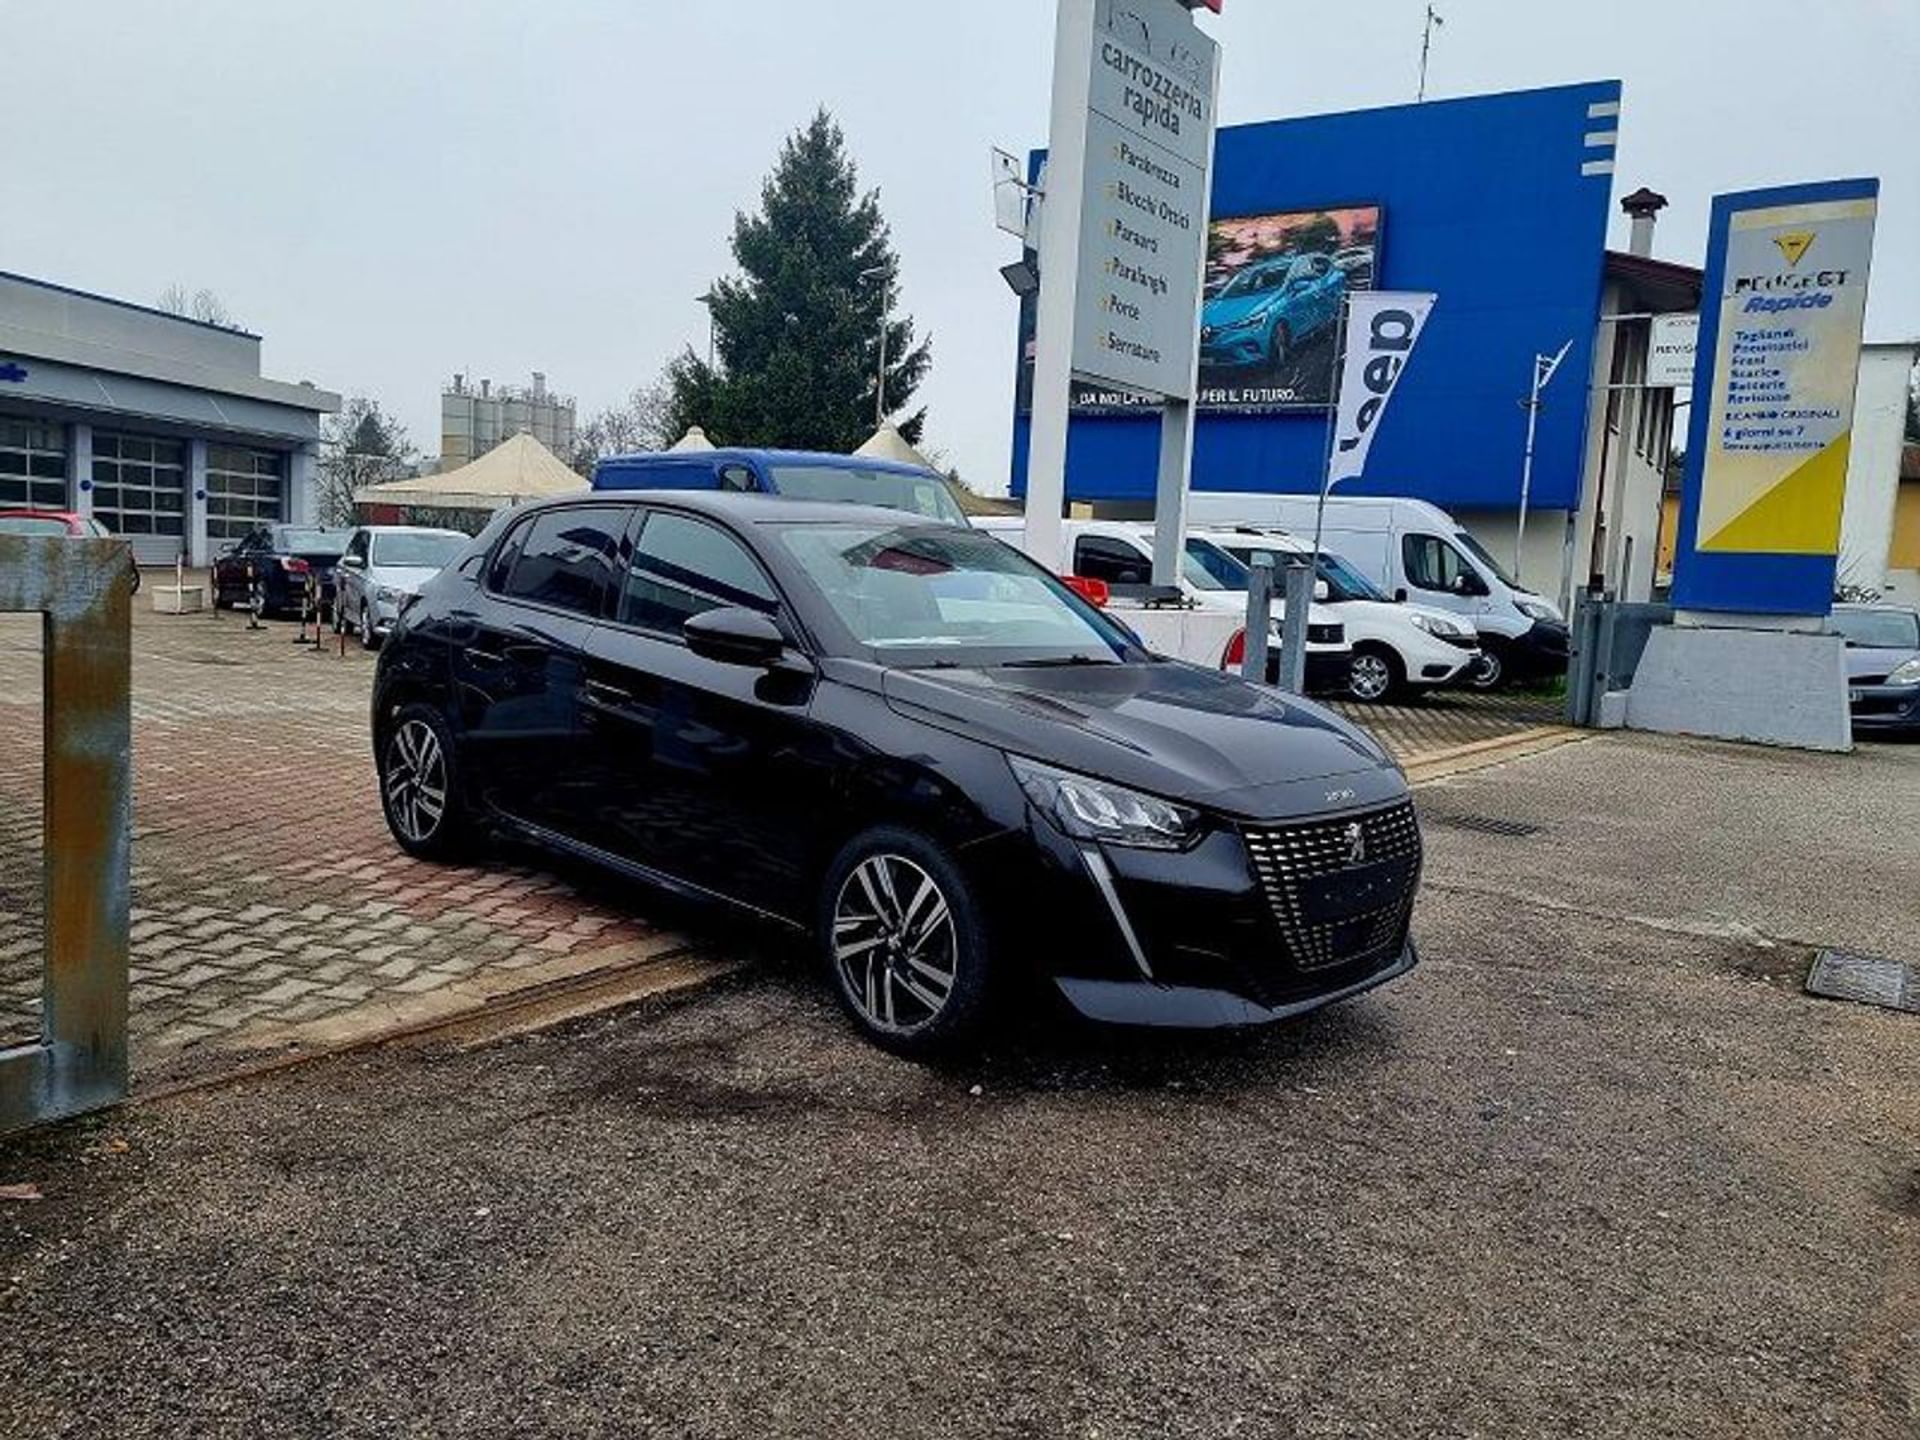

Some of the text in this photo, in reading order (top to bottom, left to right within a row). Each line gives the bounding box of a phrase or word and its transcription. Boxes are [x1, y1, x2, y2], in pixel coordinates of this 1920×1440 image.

[1102, 42, 1202, 120] carrozzeria
[1124, 86, 1180, 135] rapida
[1118, 181, 1156, 216] Blocchi
[1109, 294, 1141, 321] Porte
[1735, 329, 1795, 341] Tagliandi
[1108, 332, 1161, 363] Serrature
[1731, 355, 1766, 366] Freni
[1730, 367, 1781, 379] Scarico
[1201, 388, 1227, 402] PER
[1728, 380, 1786, 392] Batterie
